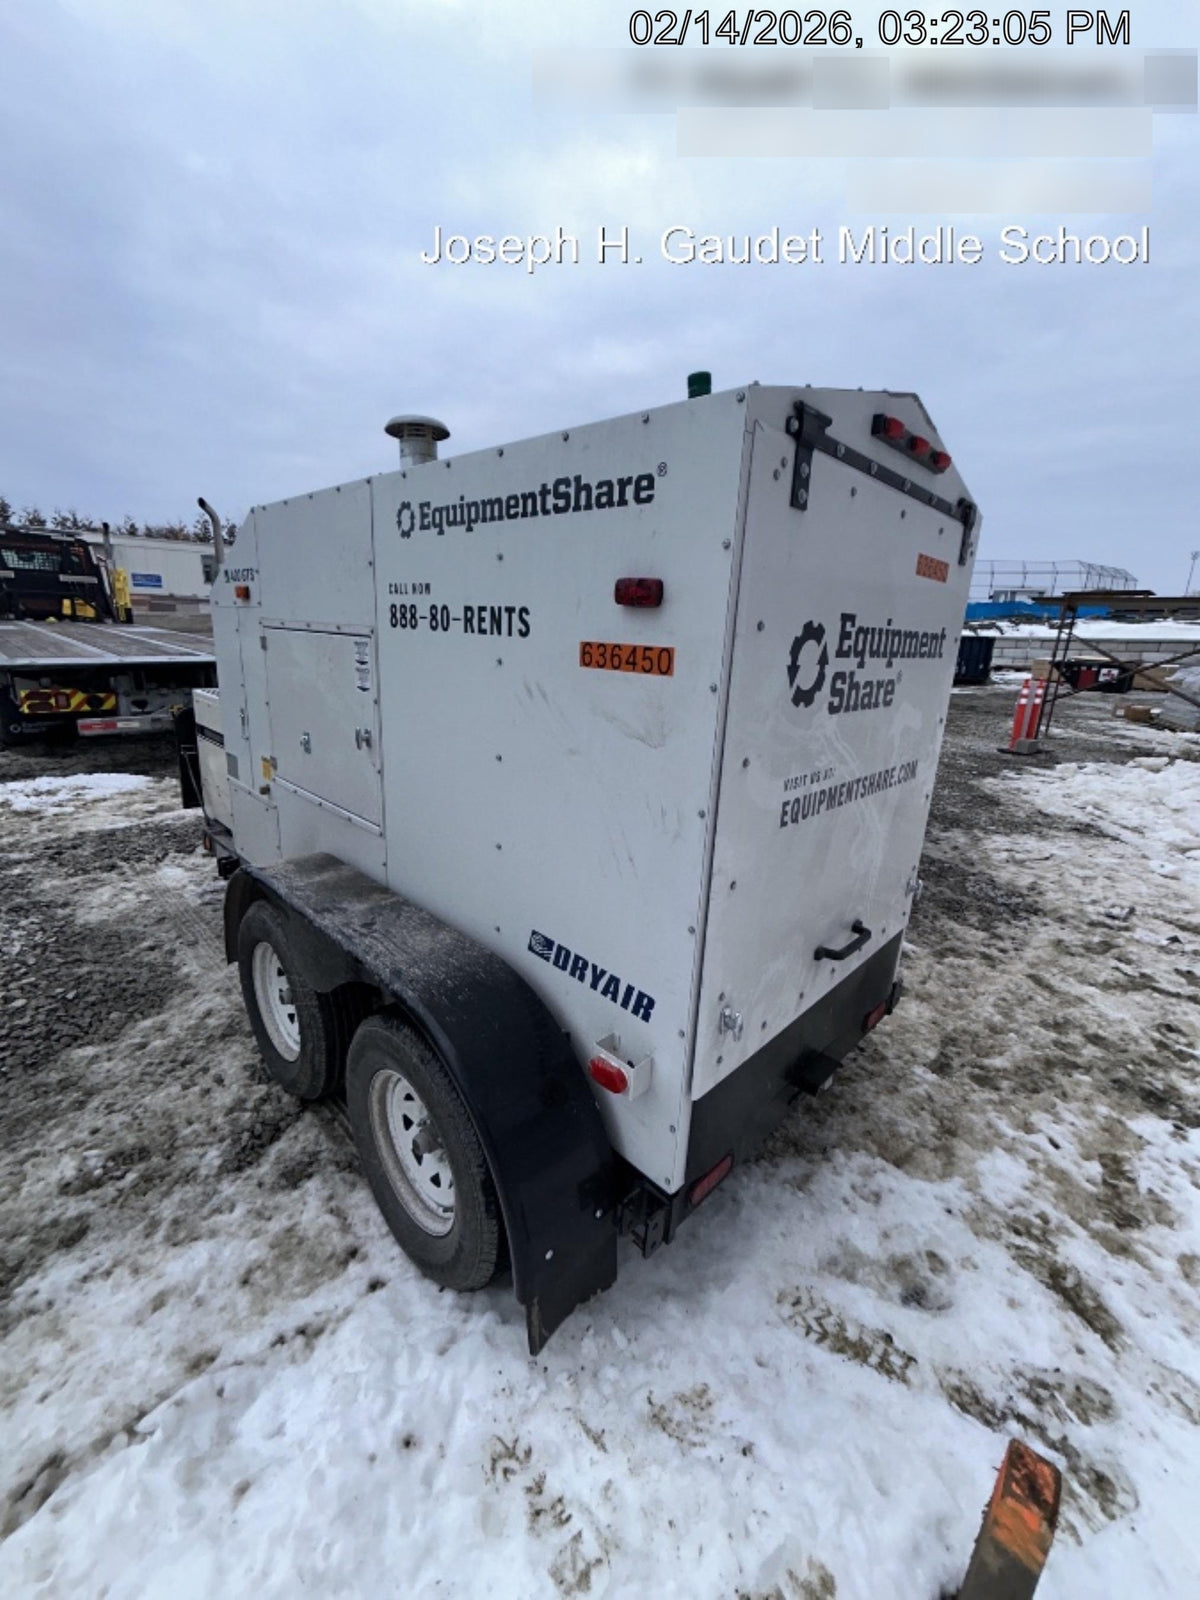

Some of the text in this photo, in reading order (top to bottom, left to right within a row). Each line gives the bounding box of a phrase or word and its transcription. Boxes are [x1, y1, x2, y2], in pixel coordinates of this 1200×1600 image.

[419, 472, 655, 535] EquipmentShare
[388, 582, 431, 595] CALL NOW
[389, 603, 531, 638] 888-80-RENTS
[835, 612, 946, 669] Equipment
[581, 643, 673, 676] 636450
[827, 670, 896, 715] Share
[780, 759, 918, 829] EQUIPMENTSHARE.COM
[784, 774, 808, 792] VISIT
[552, 943, 656, 1023] DRYAIR
